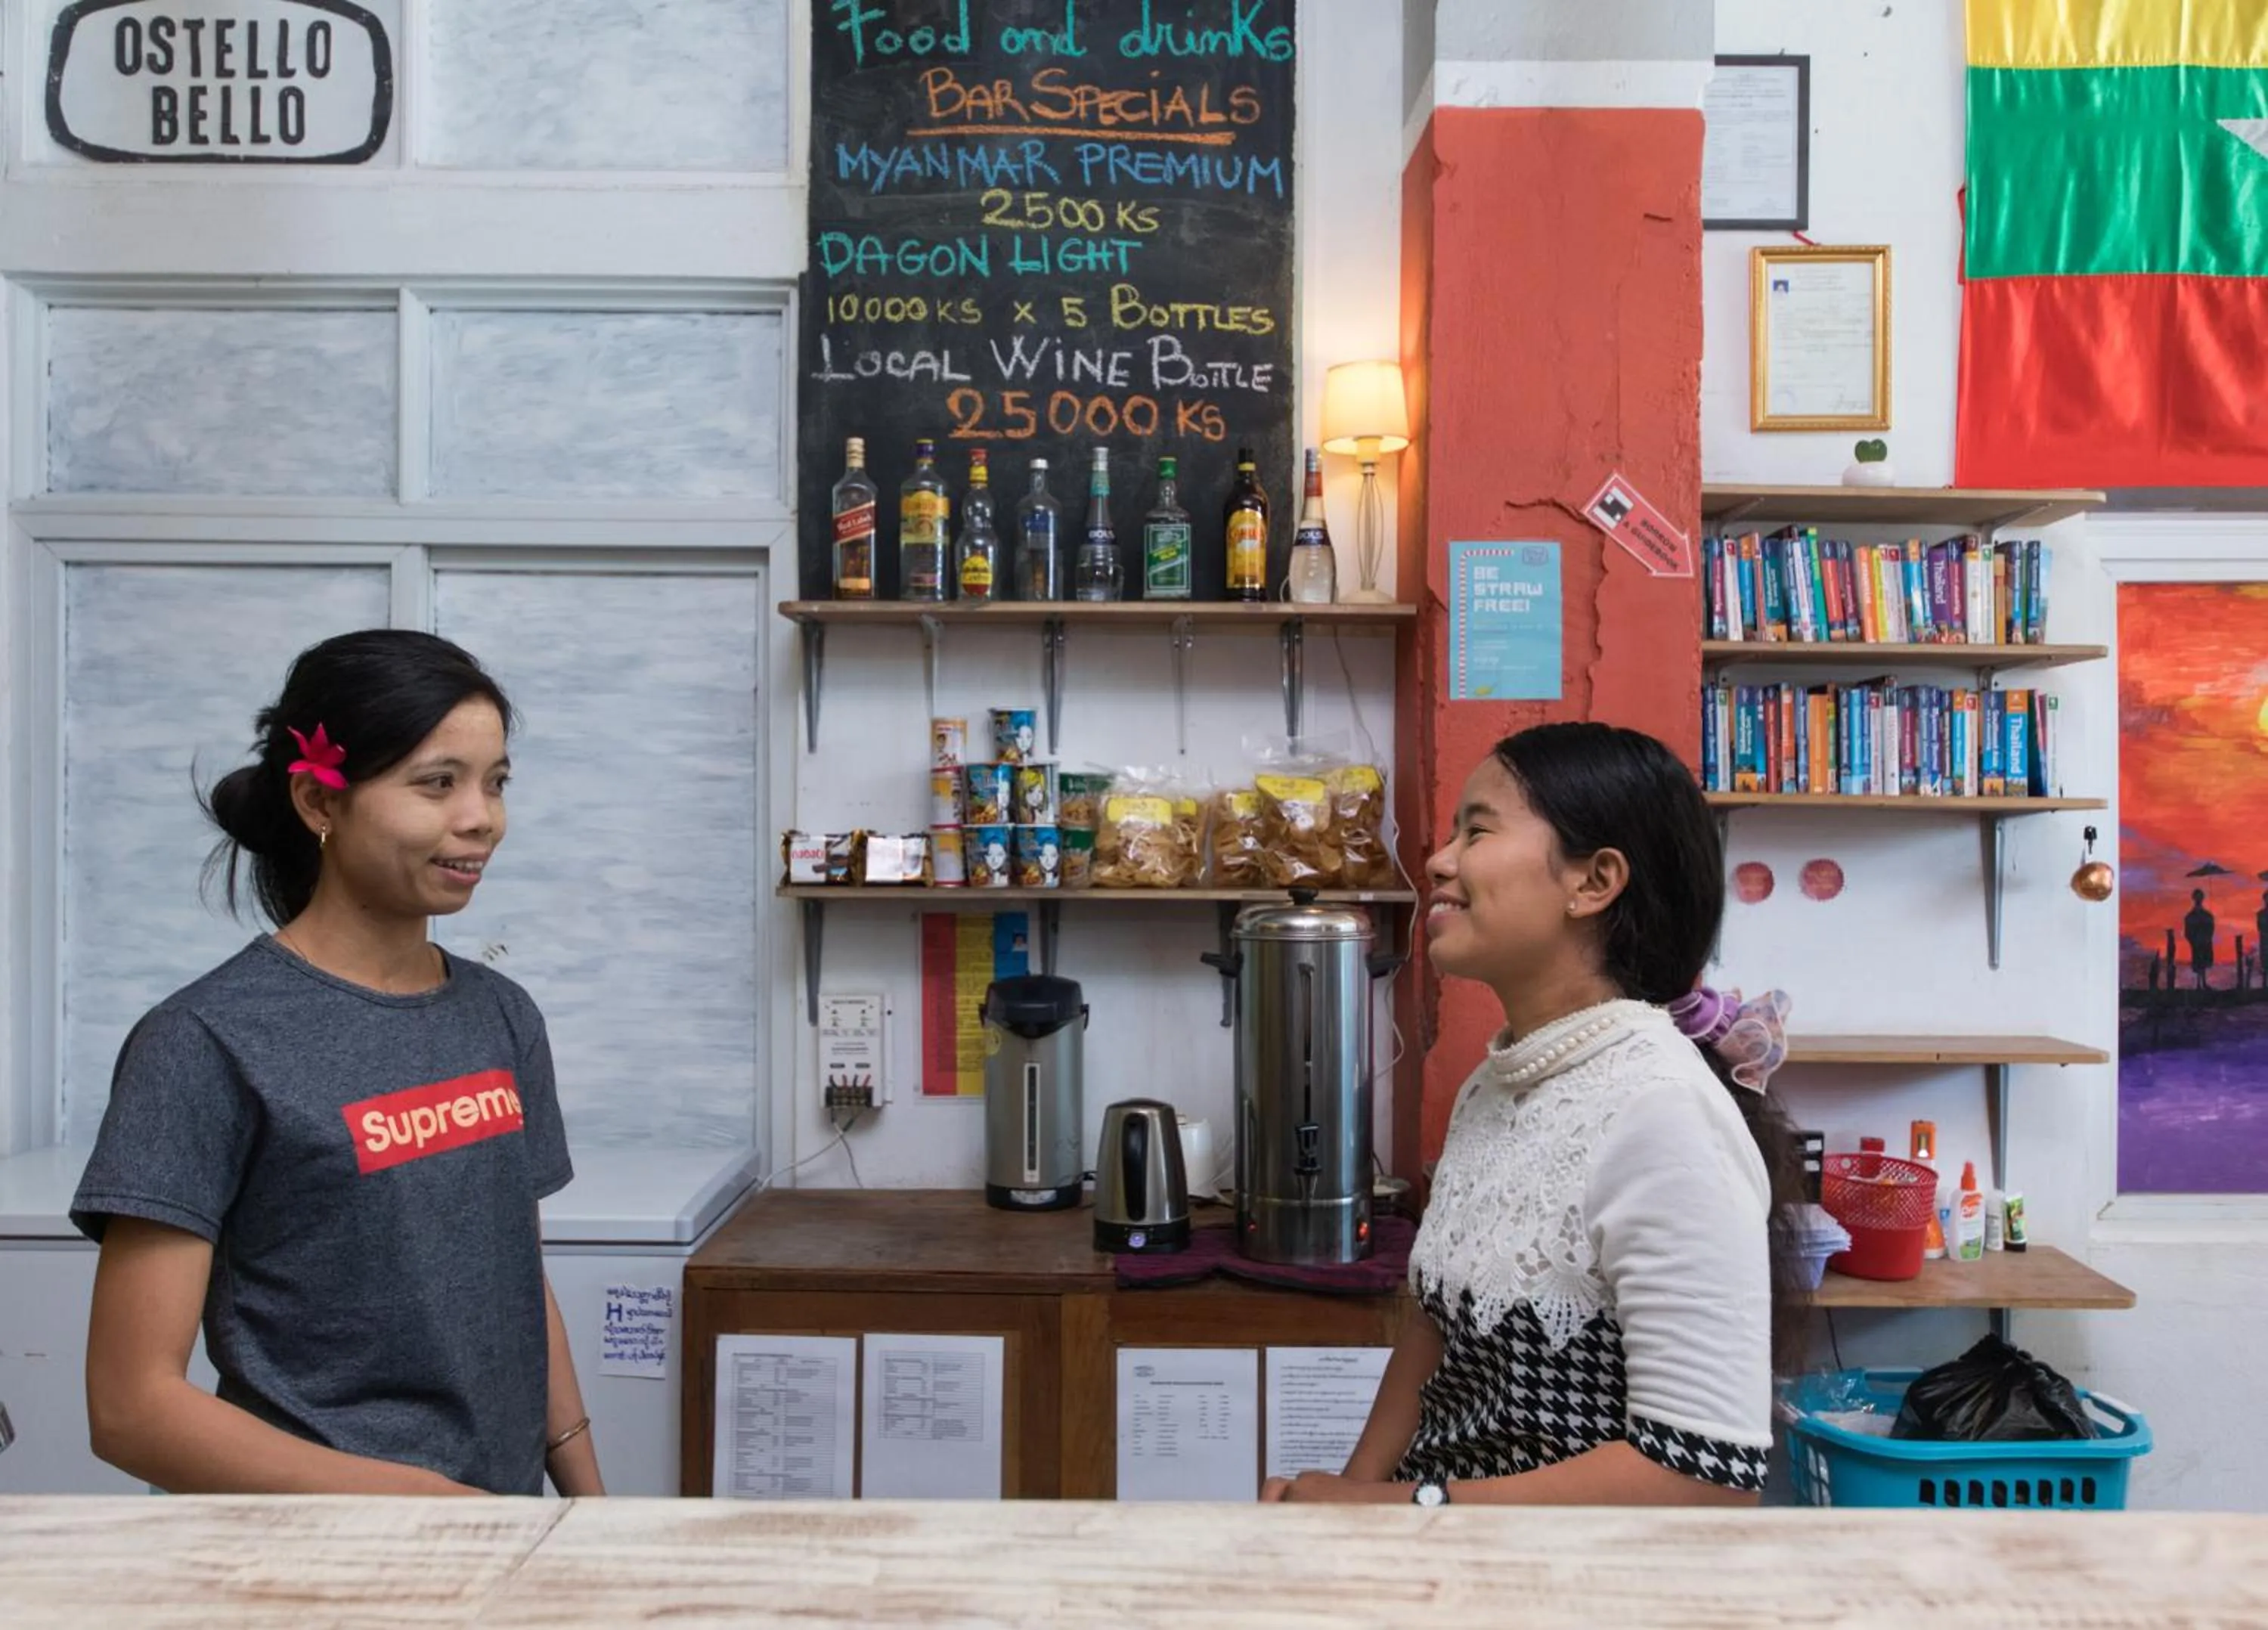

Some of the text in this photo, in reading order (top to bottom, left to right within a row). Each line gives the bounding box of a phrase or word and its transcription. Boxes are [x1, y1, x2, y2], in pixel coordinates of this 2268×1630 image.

[115, 16, 332, 79] OSTELLO
[832, 0, 969, 66] Food
[1000, 0, 1087, 57] and
[152, 85, 305, 144] BELLO
[919, 67, 1030, 122] BAR
[835, 141, 1284, 199] MYANMAR PREMIUM
[981, 188, 1105, 232] 2500
[819, 231, 1143, 277] DAGON LIGHT
[1061, 296, 1087, 327] 5
[947, 387, 1160, 438] 25000
[1473, 566, 1499, 580] BE
[1473, 582, 1543, 596] STRAW
[1933, 560, 1947, 605] Thailand
[1473, 599, 1530, 612] FREE!
[2010, 715, 2023, 774] Thailand
